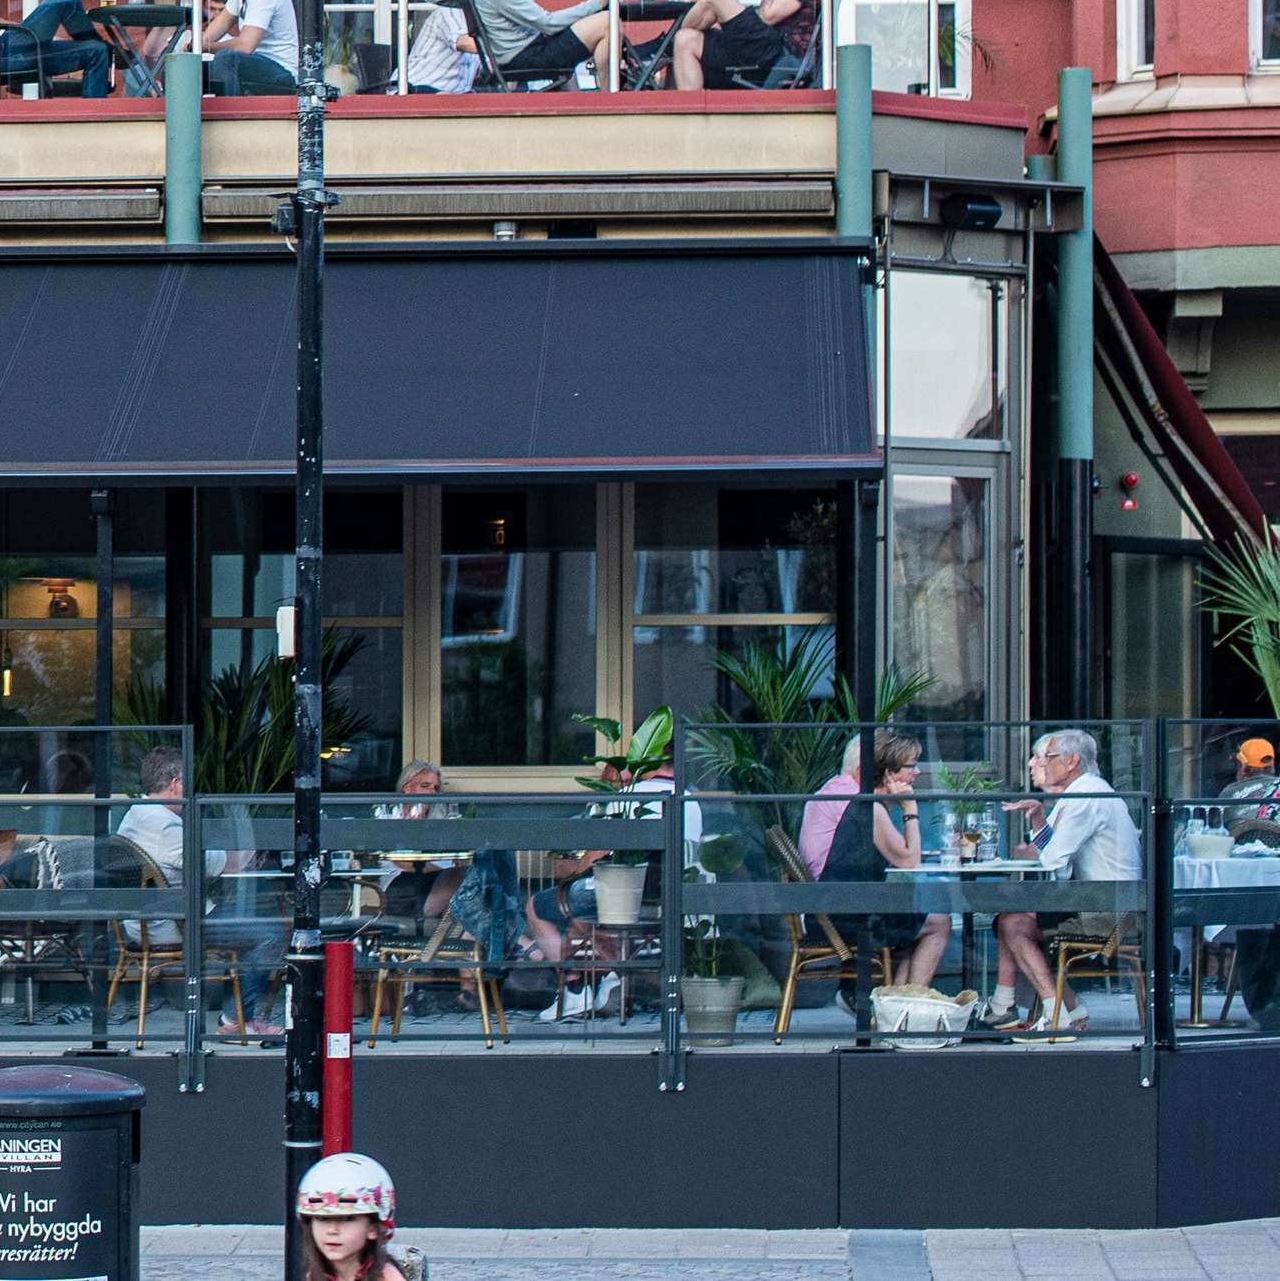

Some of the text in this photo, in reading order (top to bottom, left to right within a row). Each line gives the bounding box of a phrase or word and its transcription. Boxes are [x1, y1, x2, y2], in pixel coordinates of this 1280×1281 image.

[9, 1165, 33, 1173] HYRA
[24, 1191, 57, 1213] har
[8, 1213, 102, 1242] nybyggda
